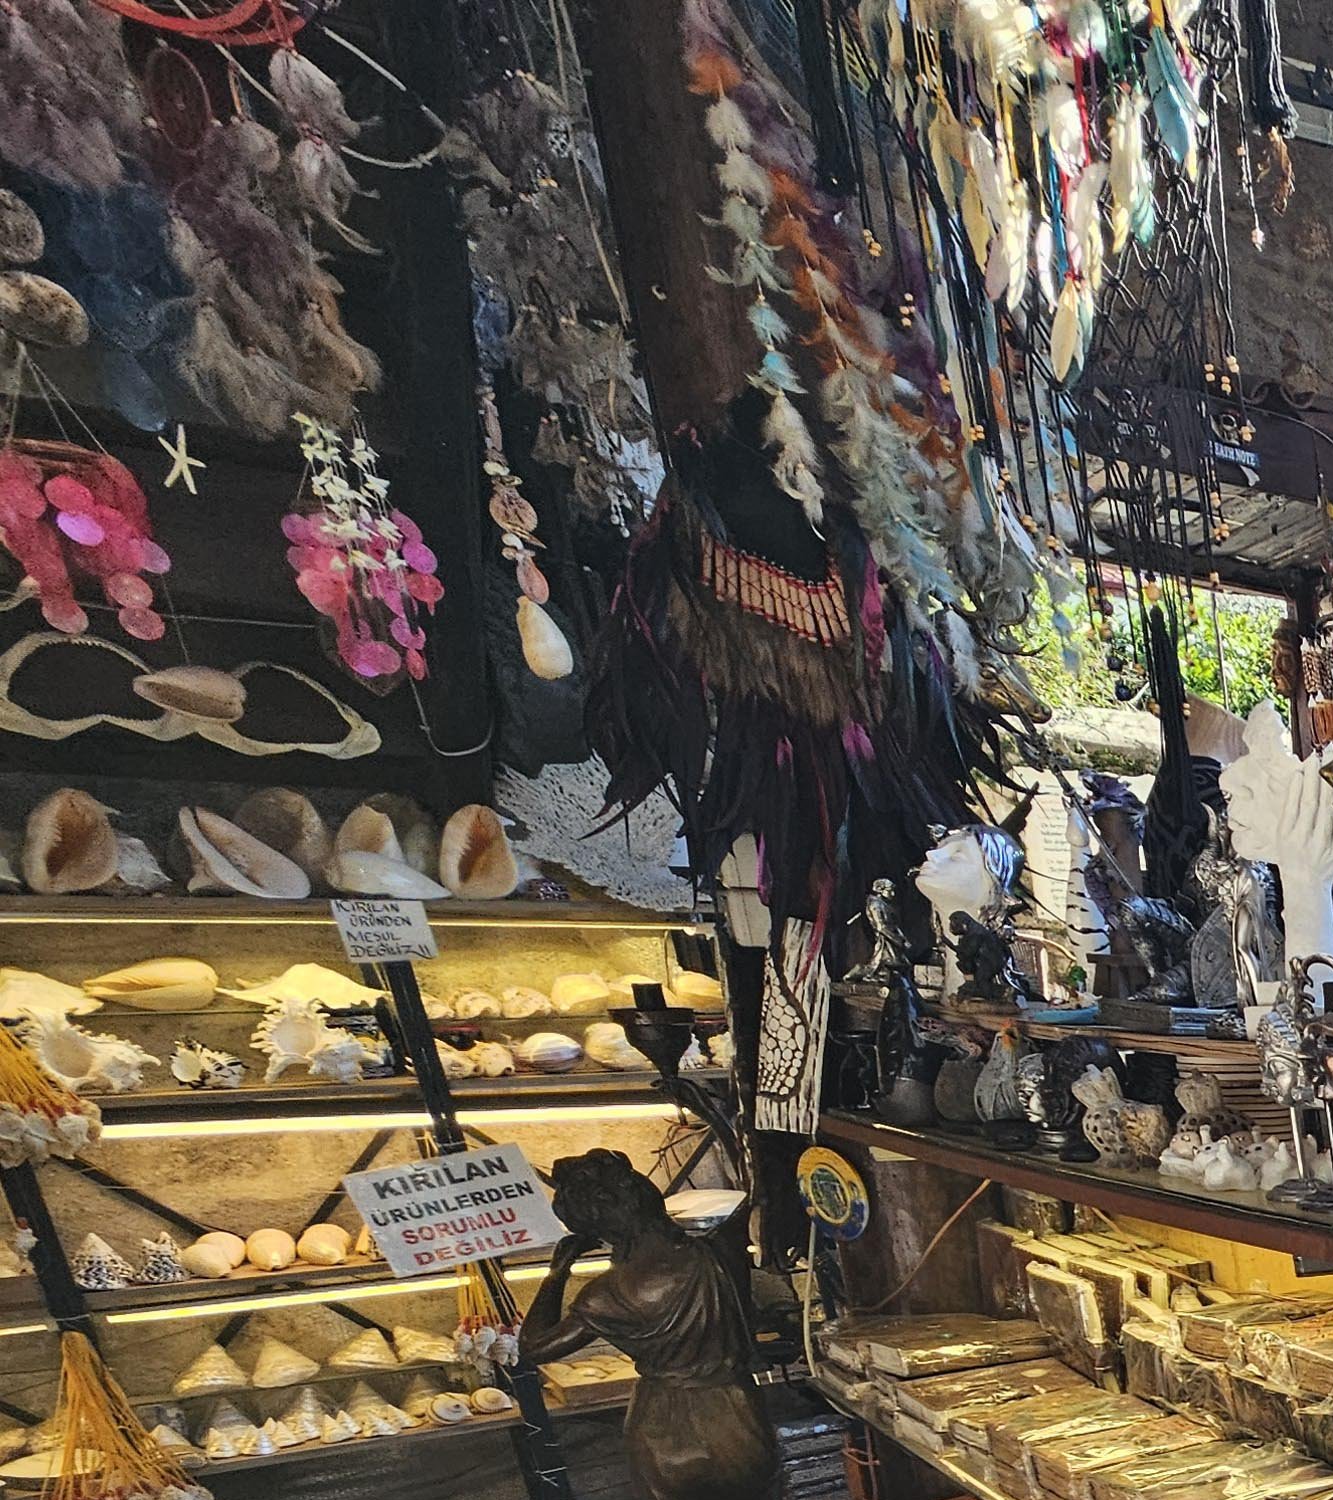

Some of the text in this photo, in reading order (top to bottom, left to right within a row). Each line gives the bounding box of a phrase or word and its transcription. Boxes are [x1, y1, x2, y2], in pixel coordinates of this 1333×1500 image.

[349, 914, 412, 927] ÜRÜNDEN
[373, 1156, 510, 1200] KIRILAN
[370, 1180, 534, 1228] ÜRÜNLERDEN
[401, 1207, 517, 1245] SORUMLU
[413, 1228, 533, 1266] DEĞİLİZ
